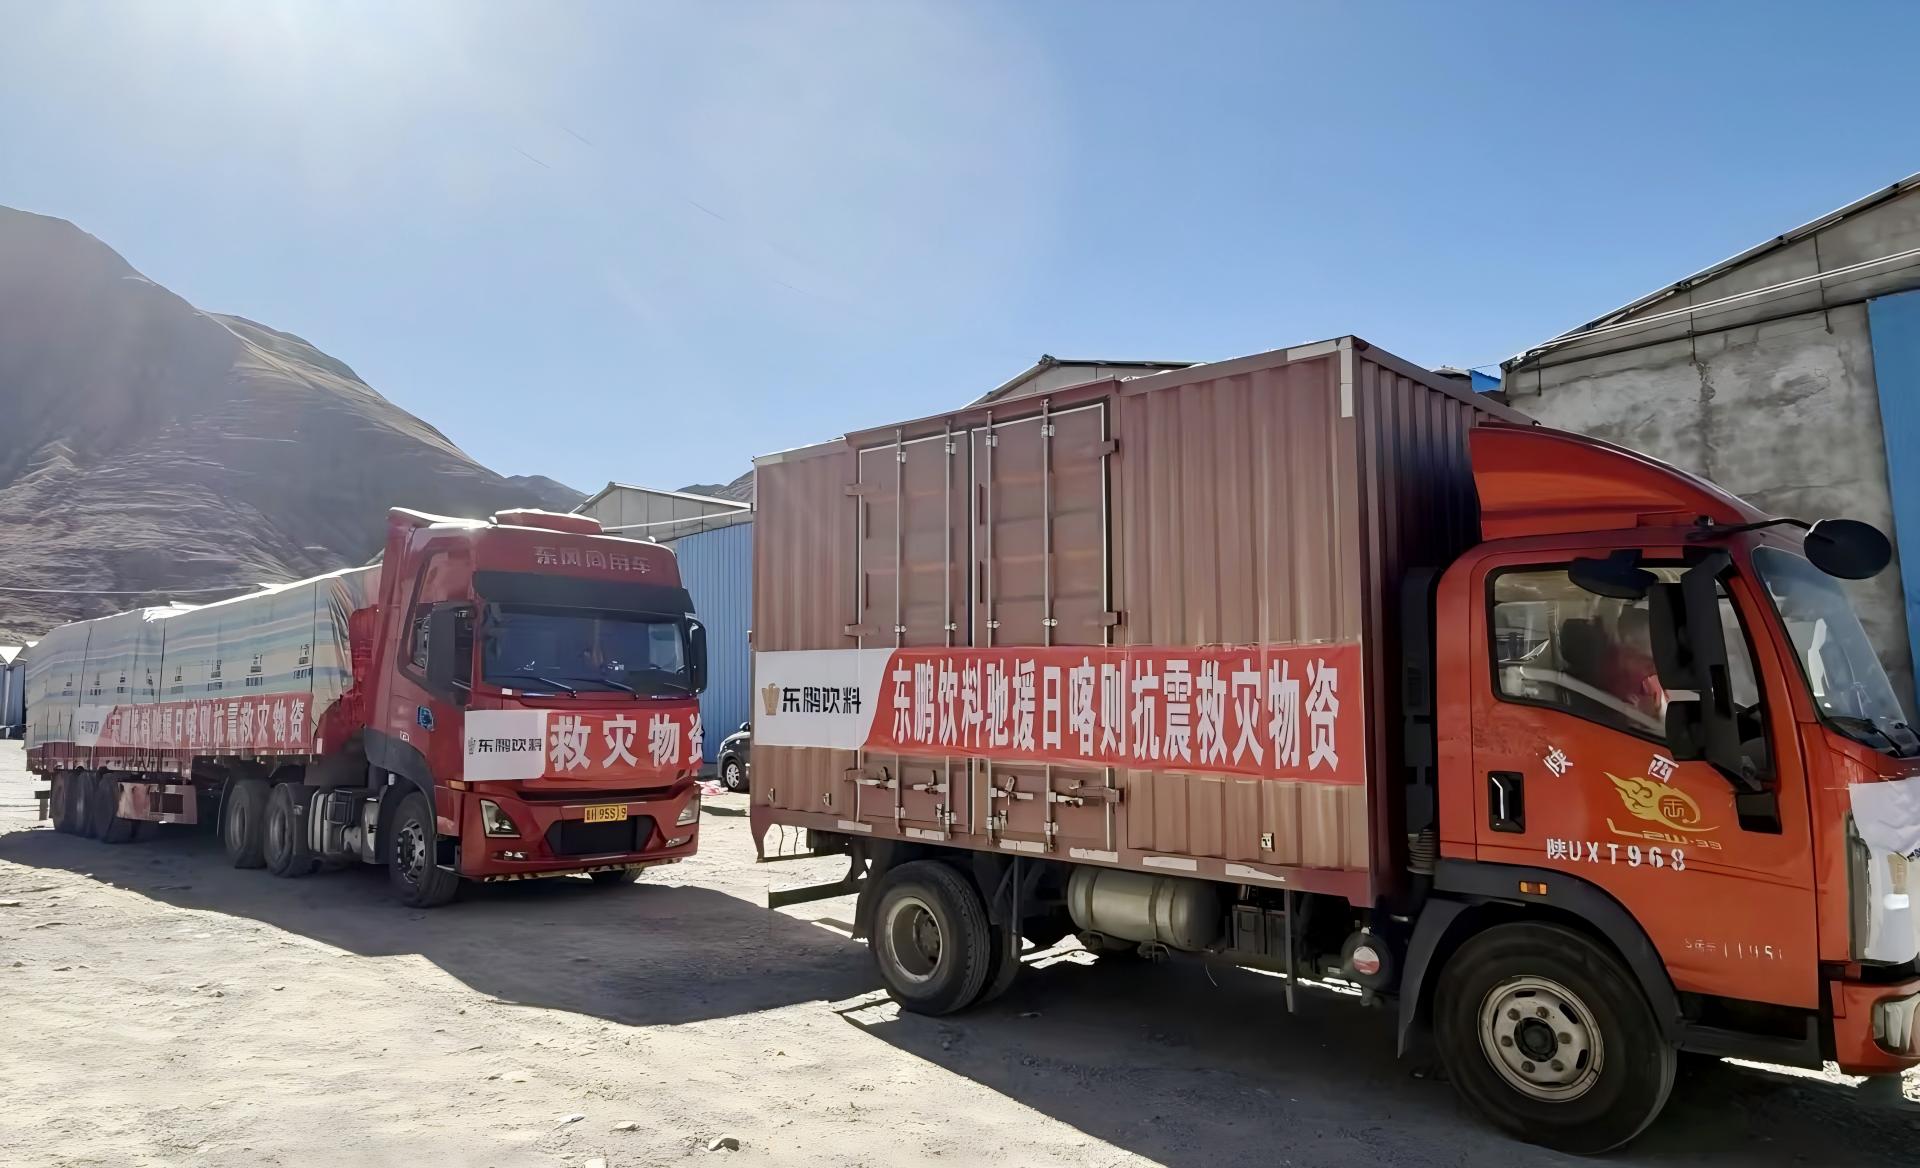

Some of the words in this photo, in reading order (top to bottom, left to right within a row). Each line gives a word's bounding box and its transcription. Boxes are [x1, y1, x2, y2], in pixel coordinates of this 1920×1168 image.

[783, 687, 861, 714] 东鹏饮料
[893, 656, 1339, 772] 东鹏饮料驰援日喀则抗震救灾物资
[479, 738, 542, 753] 东鹏饮料
[1546, 838, 1686, 871] 陕UXT968
